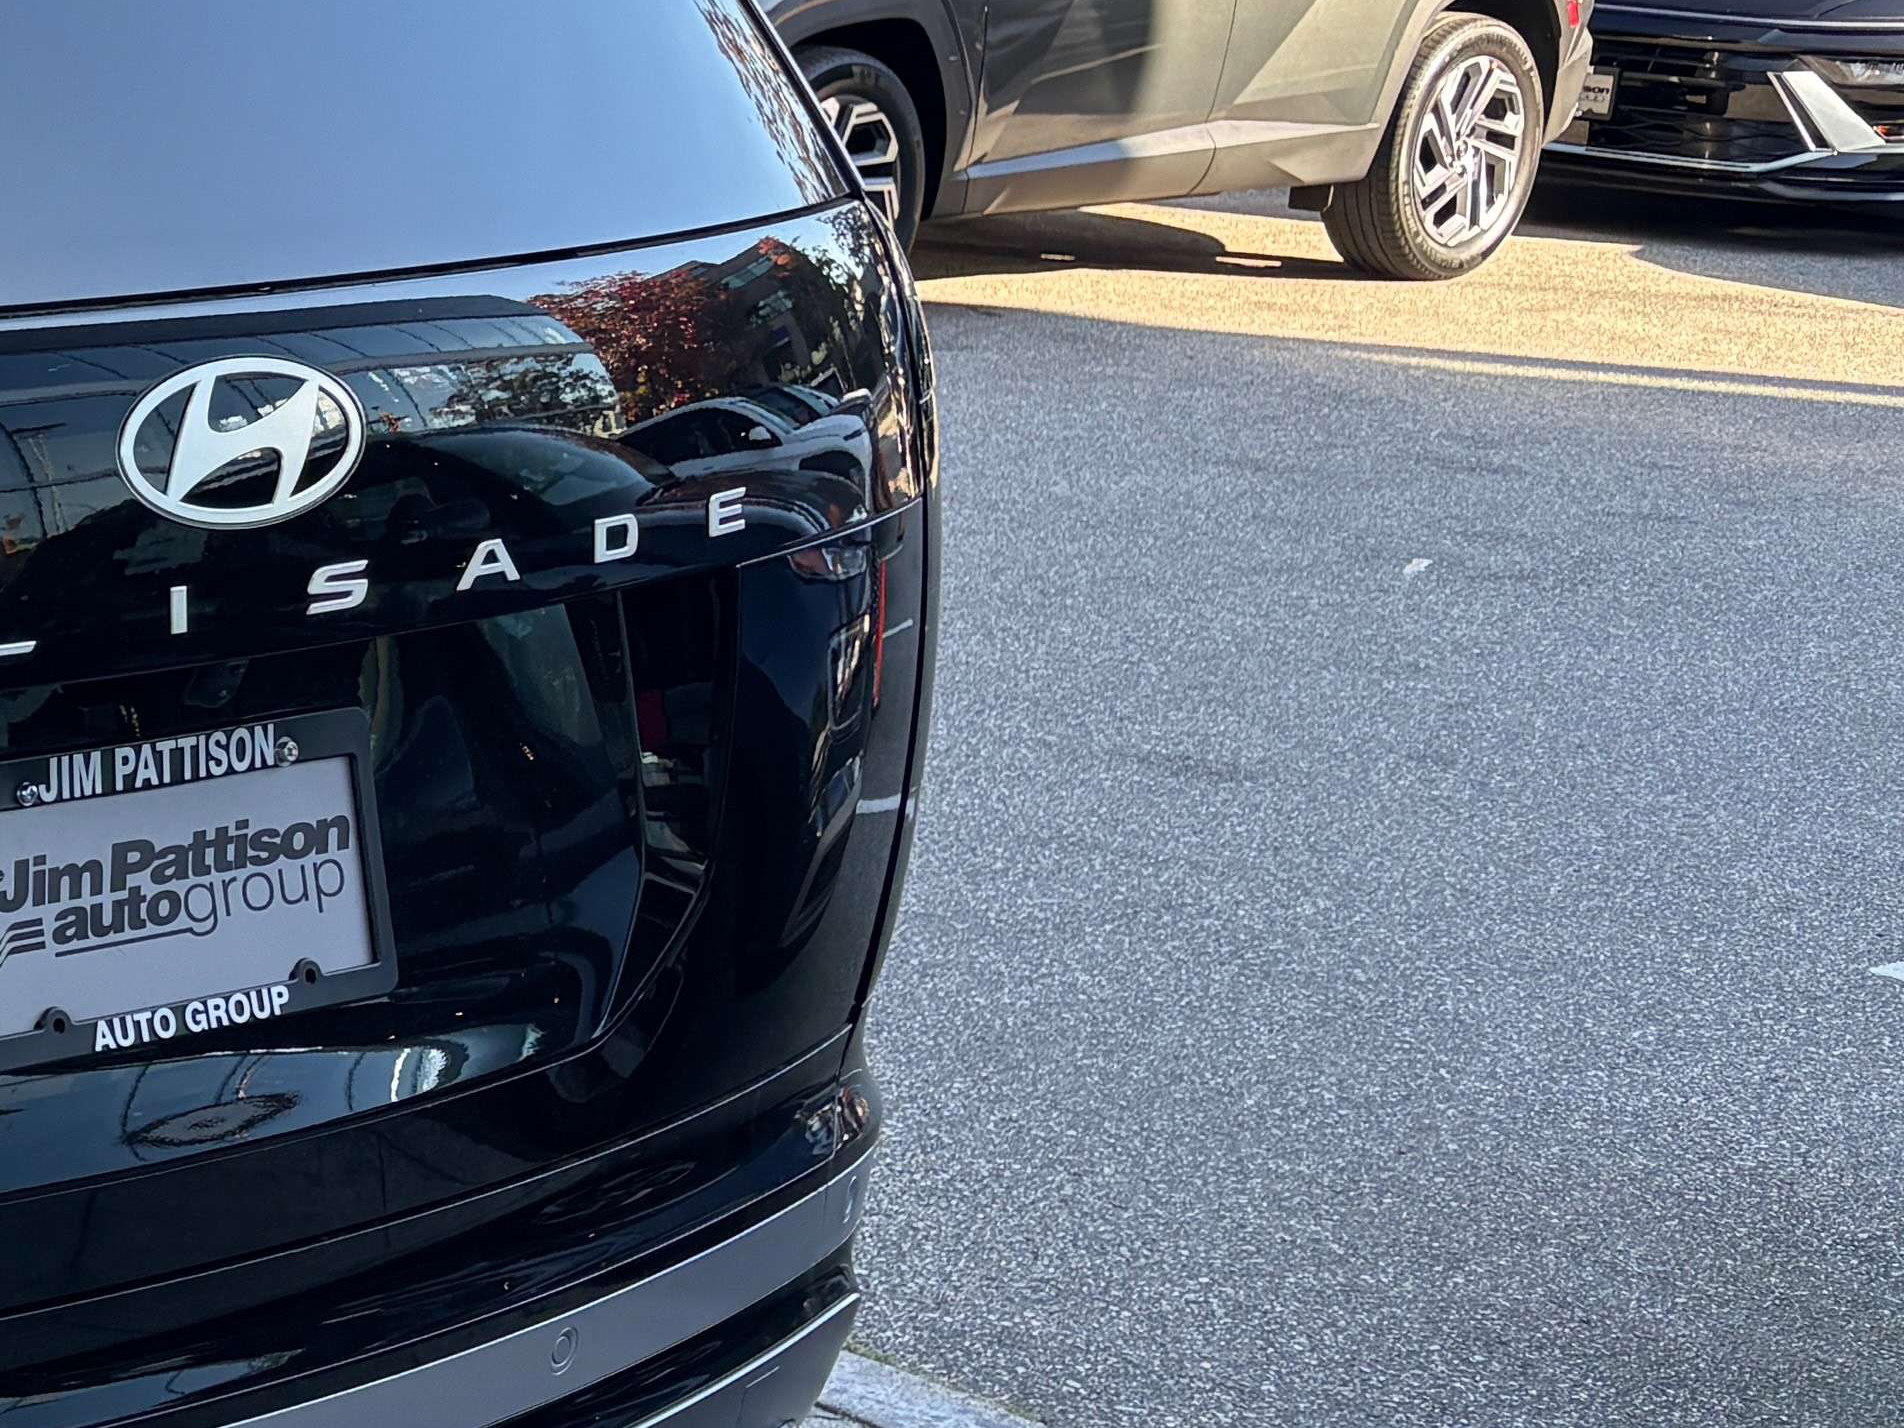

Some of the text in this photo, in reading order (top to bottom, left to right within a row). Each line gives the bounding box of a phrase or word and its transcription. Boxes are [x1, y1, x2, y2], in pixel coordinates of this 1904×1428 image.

[39, 723, 275, 803] JIM PATTISON
[109, 814, 350, 892] Pattison
[94, 984, 290, 1052] AUTO GROUP
